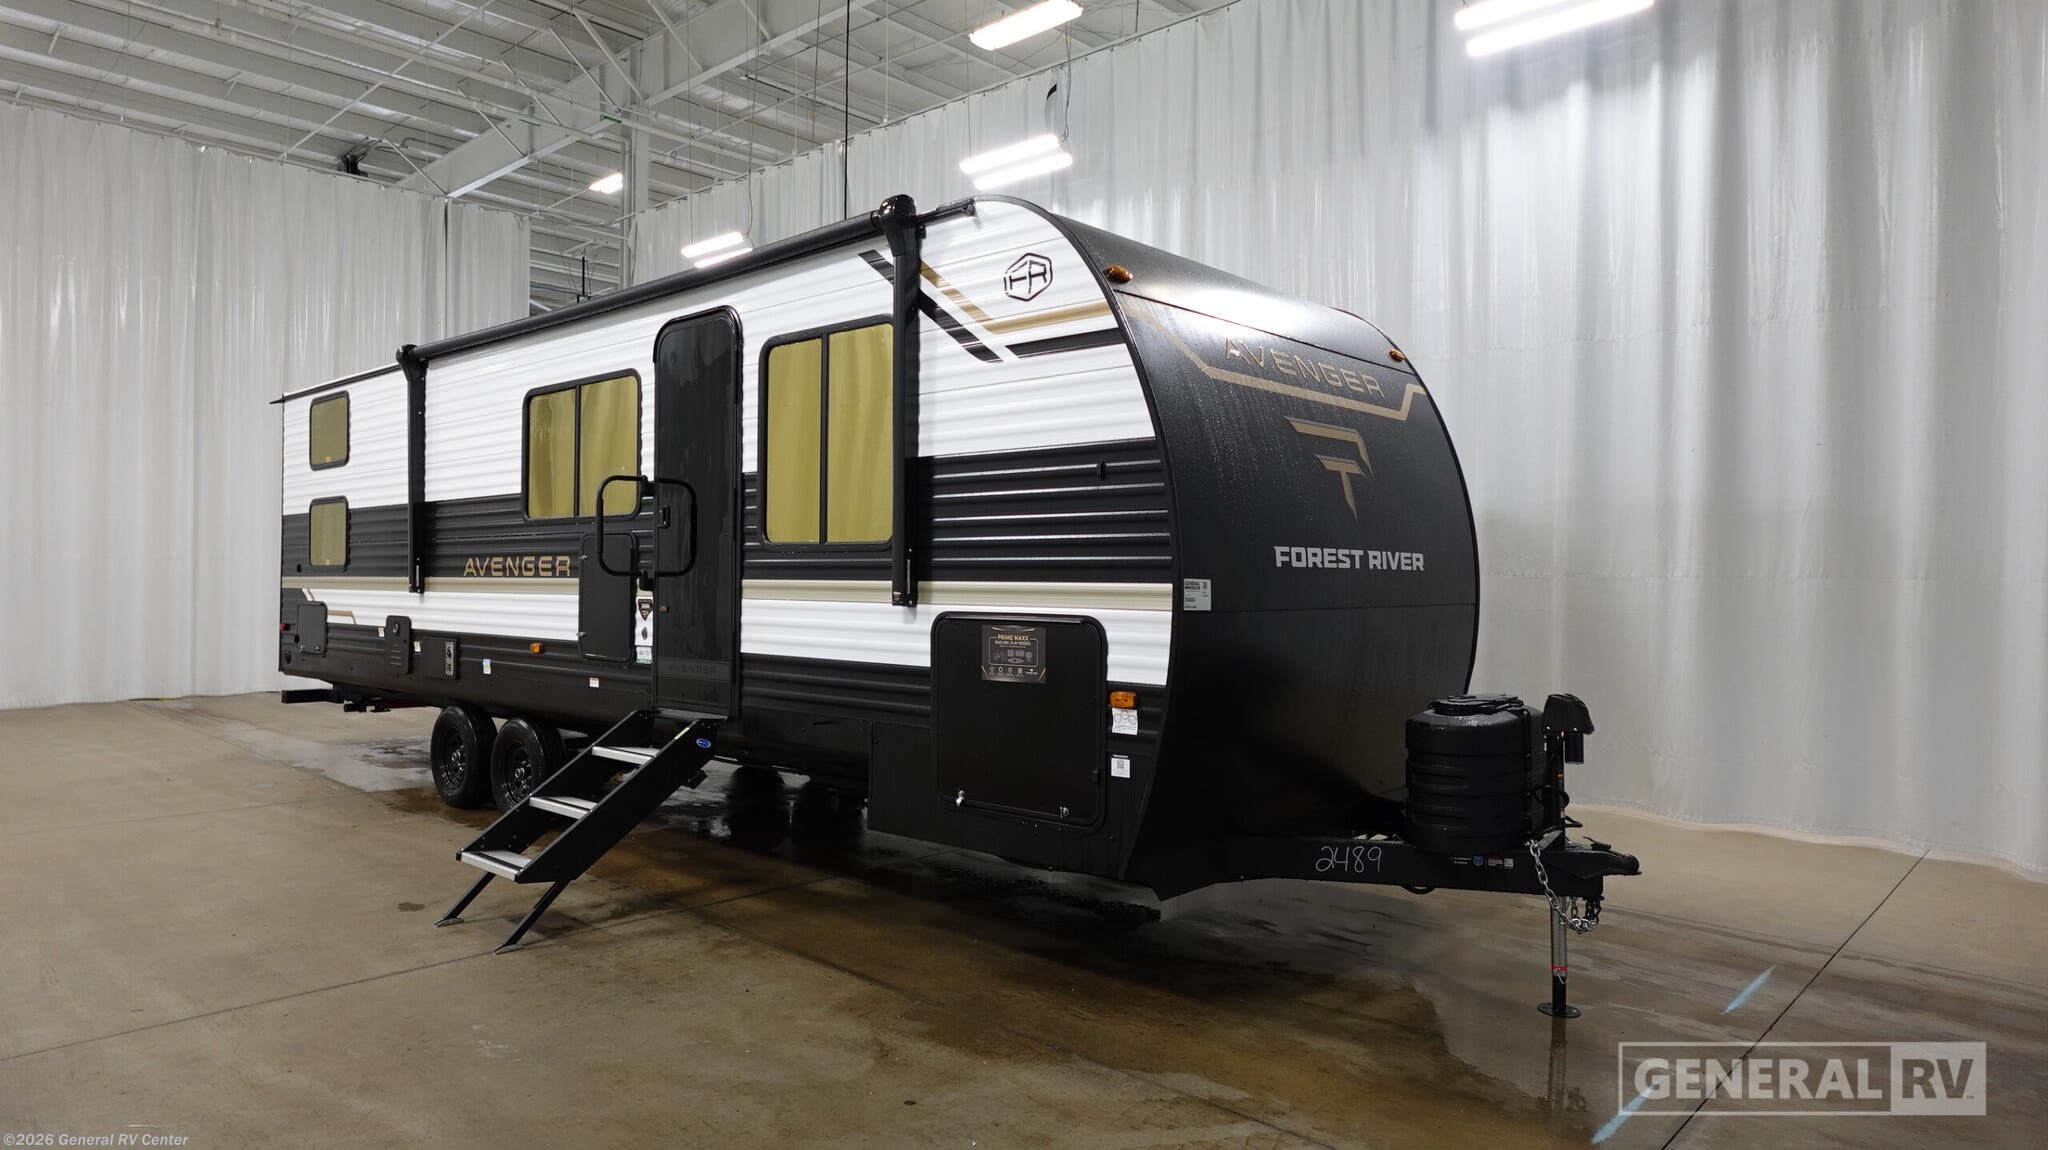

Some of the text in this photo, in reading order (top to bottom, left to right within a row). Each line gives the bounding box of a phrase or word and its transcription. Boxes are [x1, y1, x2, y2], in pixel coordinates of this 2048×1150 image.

[1225, 338, 1385, 399] AVENGER
[463, 556, 571, 577] AVENGER
[1274, 545, 1425, 571] FOREST RIVER
[1315, 845, 1382, 873] 2489
